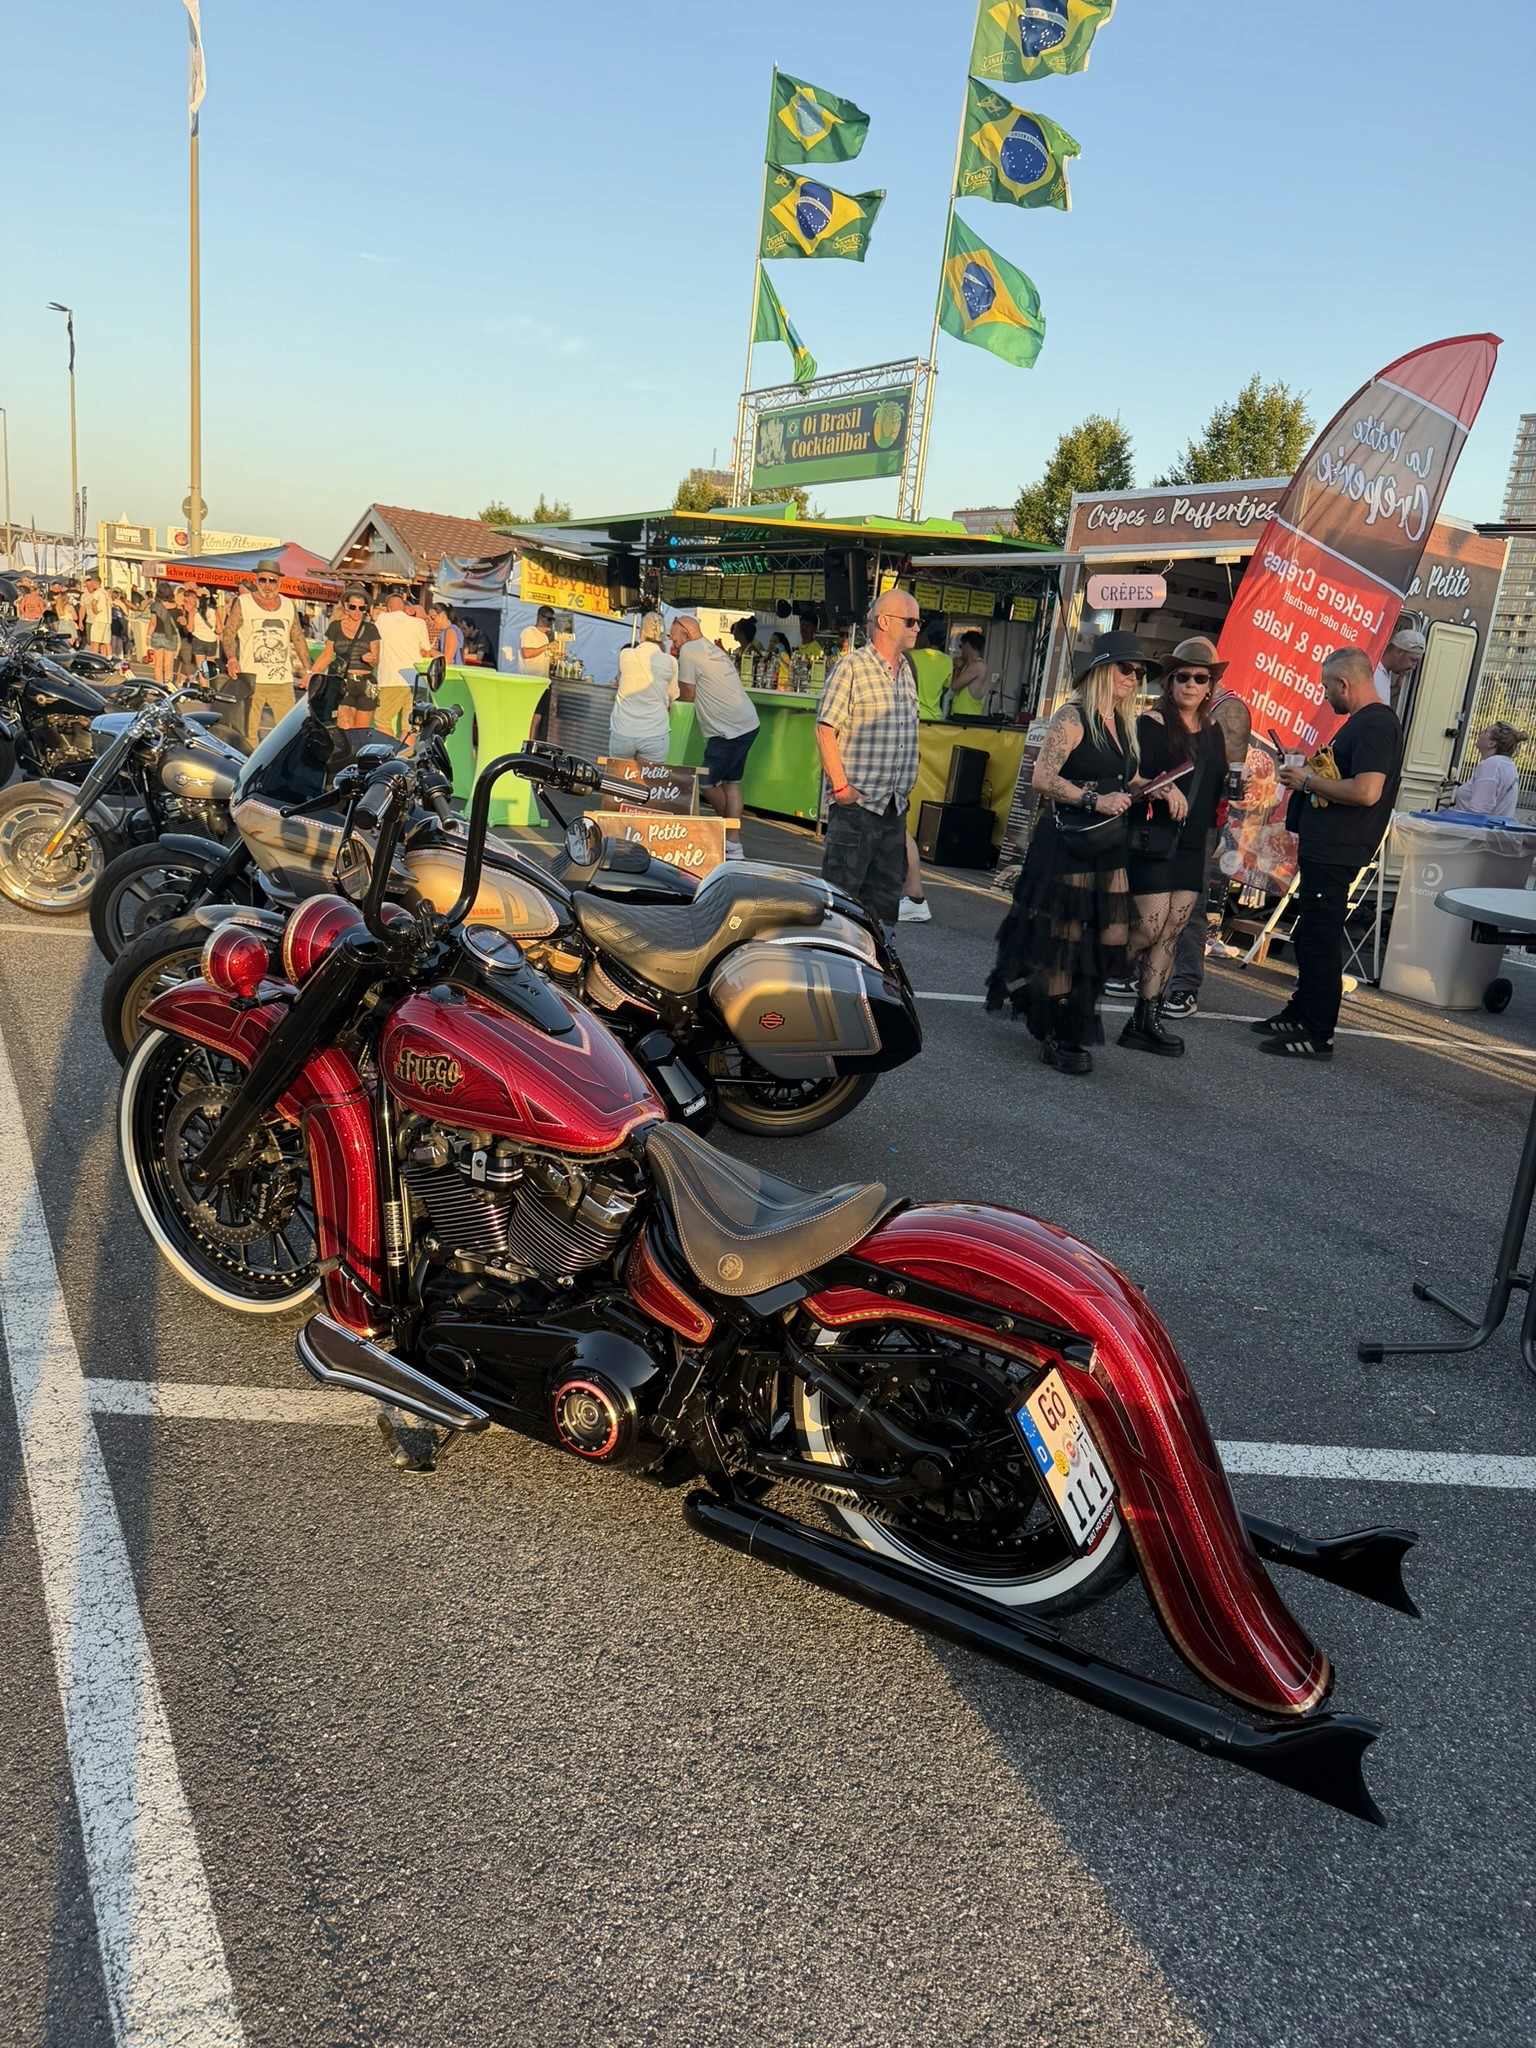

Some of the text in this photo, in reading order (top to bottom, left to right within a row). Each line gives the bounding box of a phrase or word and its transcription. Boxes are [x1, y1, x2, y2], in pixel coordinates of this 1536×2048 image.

[802, 407, 862, 436] Oi Brasil
[790, 431, 871, 459] Cocktailbar
[1087, 495, 1277, 532] Crêpes & Poffertjes
[232, 535, 274, 549] Pilsener
[527, 556, 607, 584] COCKTA
[1426, 565, 1472, 599] Petite
[527, 572, 610, 599] HAPPY HOU
[1101, 582, 1153, 601] CRÊPES
[567, 592, 585, 608] 7€
[624, 765, 673, 780] La Petite
[625, 822, 688, 843] La Petite
[1037, 1381, 1067, 1432] GÖ
[1037, 1445, 1048, 1464] D
